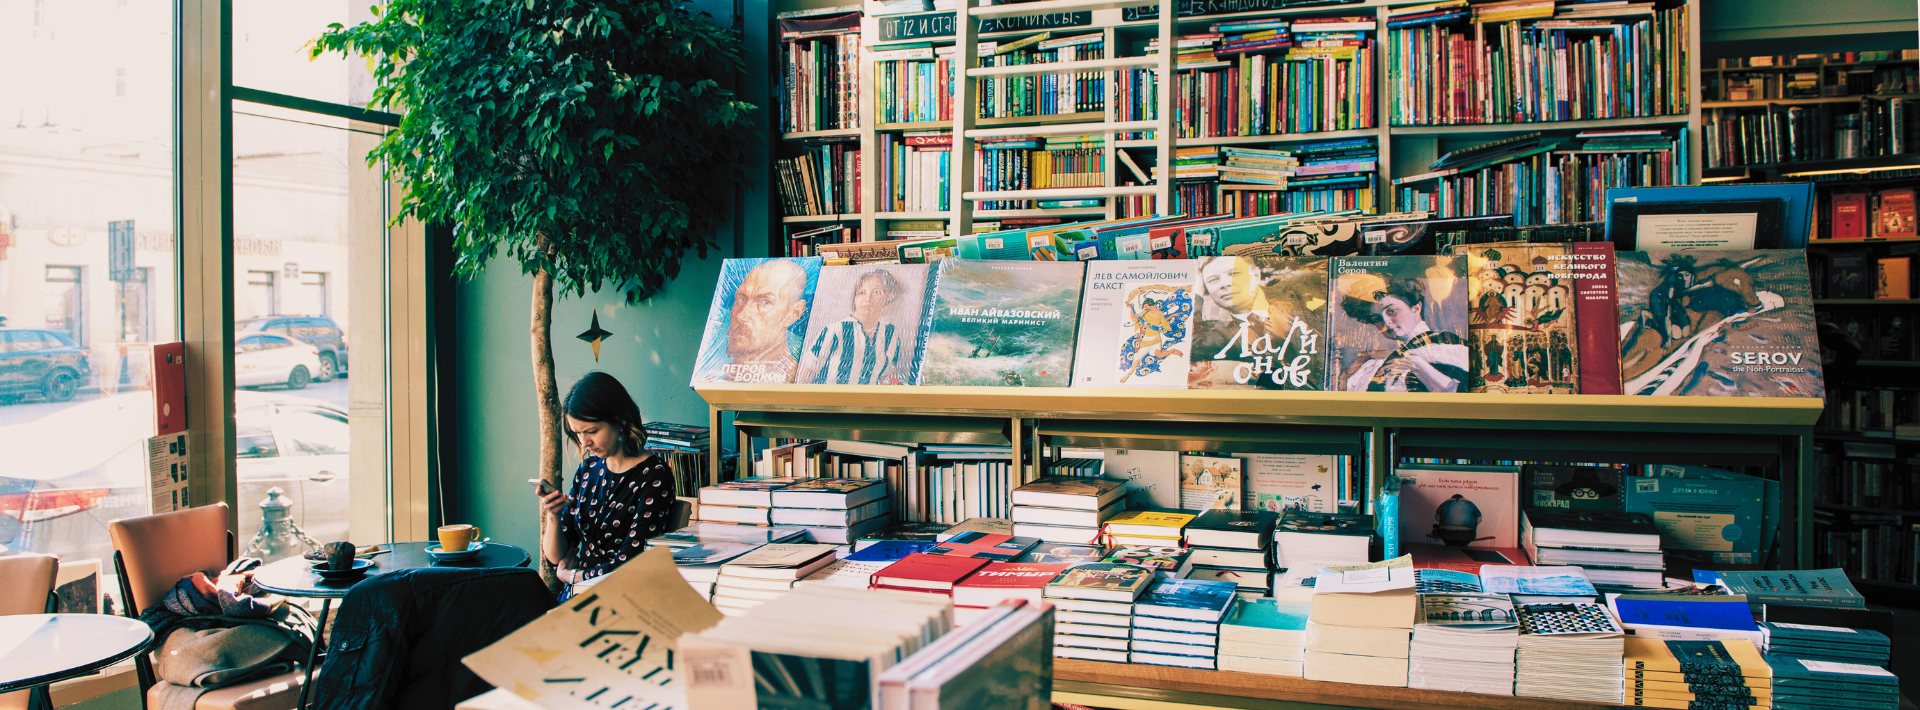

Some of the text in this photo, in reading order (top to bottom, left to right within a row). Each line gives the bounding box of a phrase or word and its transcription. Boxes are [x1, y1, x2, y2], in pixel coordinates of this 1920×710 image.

[903, 18, 914, 36] 12
[919, 19, 928, 35] И
[1547, 254, 1606, 263] ИСКУССТВО
[1337, 259, 1389, 268] Валентин
[1115, 271, 1188, 280] САМОЙЛОВИЧ
[1337, 267, 1368, 275] Серов
[1093, 282, 1124, 290] БАКСТ
[949, 307, 1061, 319] ИВАН АЙВАЗОВСКИЙ
[961, 316, 1046, 326] ВЕЛИКИЙ МАРИНИСТ
[1730, 352, 1803, 365] SEROV
[721, 363, 767, 374] ПЕТРОВ
[1746, 365, 1805, 373] Non-Portraitist
[1387, 517, 1395, 540] МОРЯ
[978, 570, 1056, 578] ТИМУР
